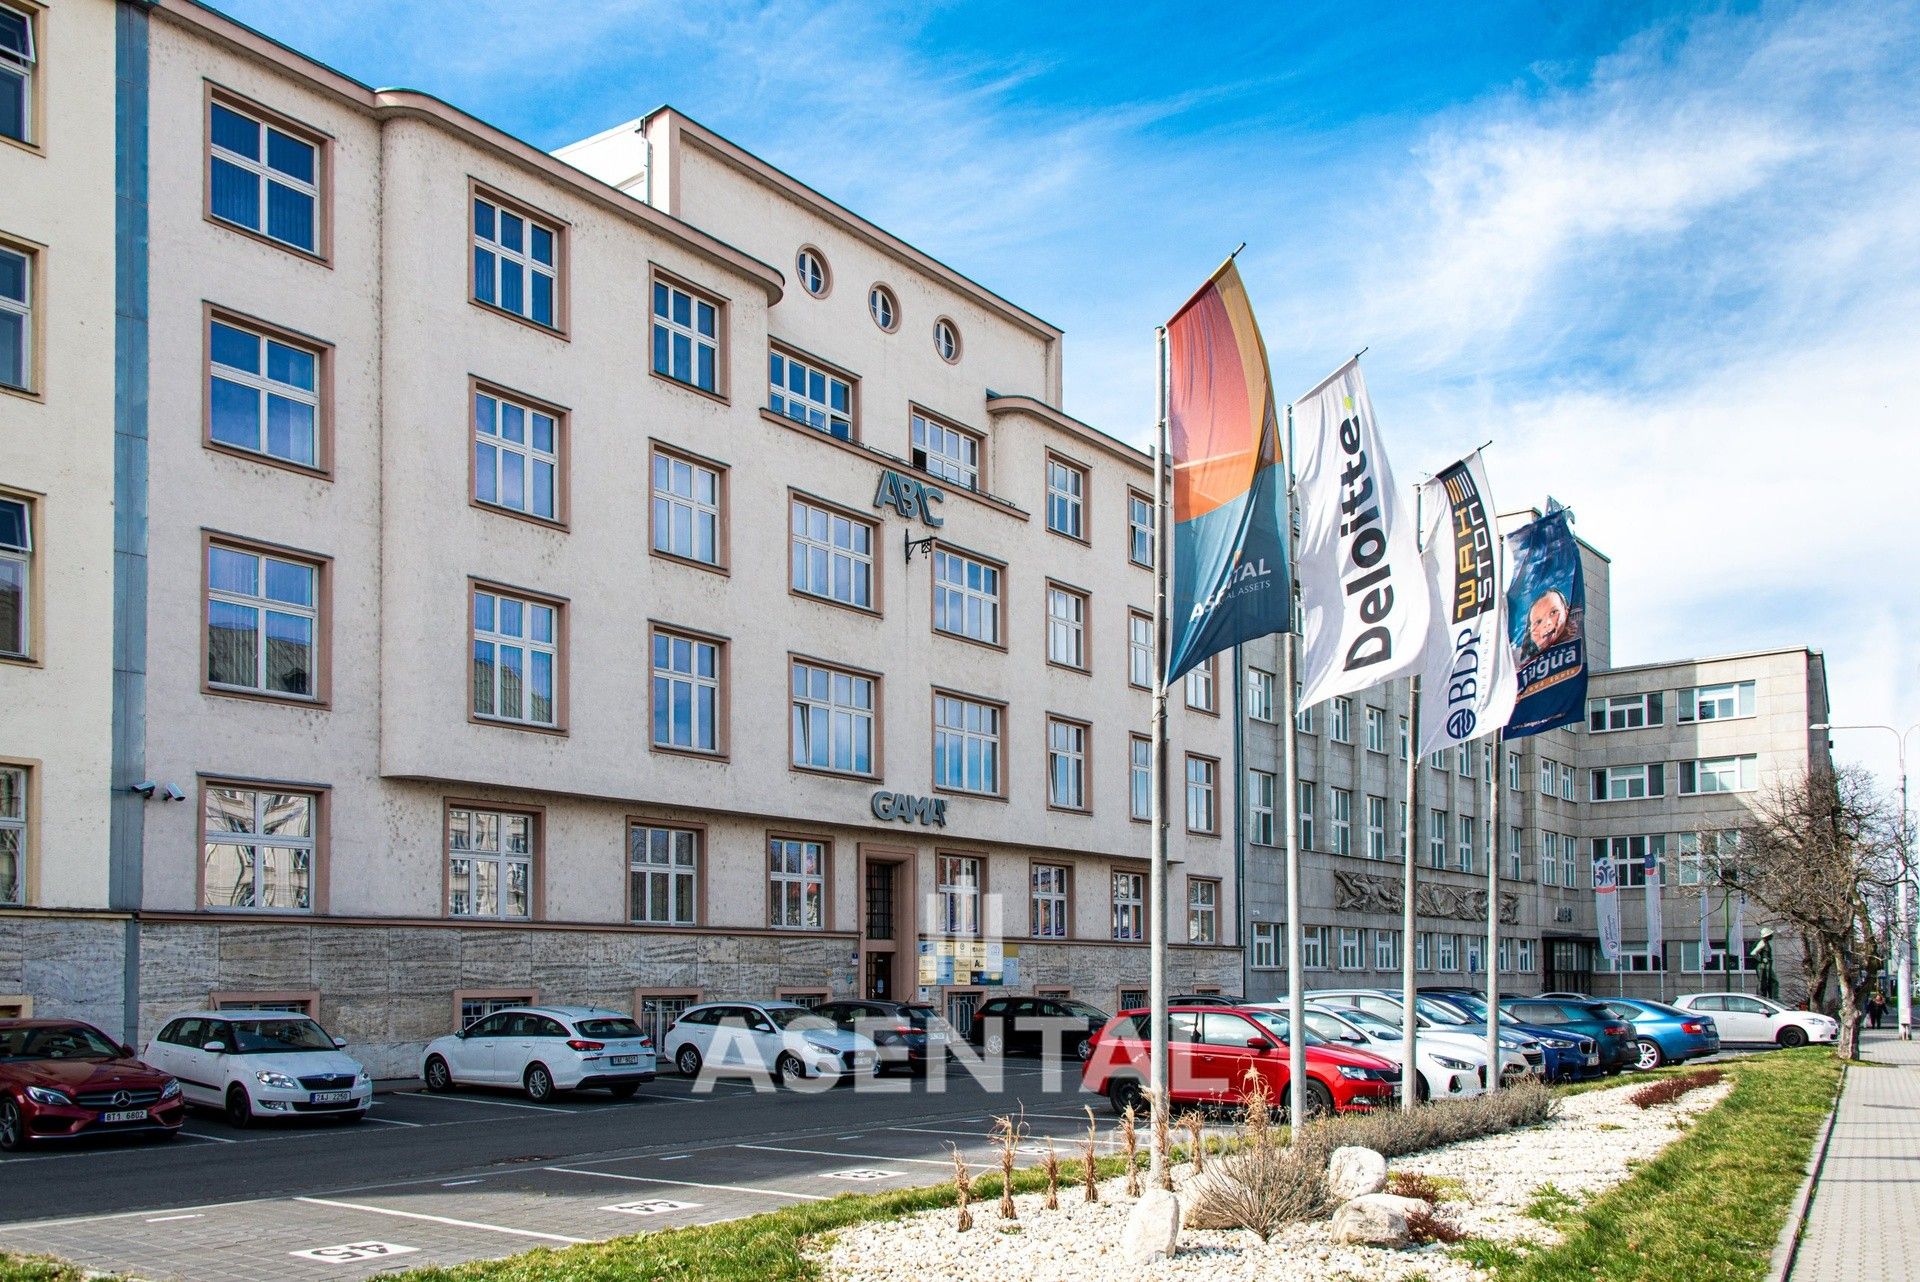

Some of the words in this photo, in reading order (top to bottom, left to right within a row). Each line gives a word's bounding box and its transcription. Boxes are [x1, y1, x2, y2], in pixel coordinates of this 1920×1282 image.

[873, 469, 945, 528] ABC
[1238, 580, 1270, 596] ASSETS
[1448, 628, 1481, 709] BDP
[871, 790, 947, 827] GAMA
[311, 1245, 389, 1260] 45
